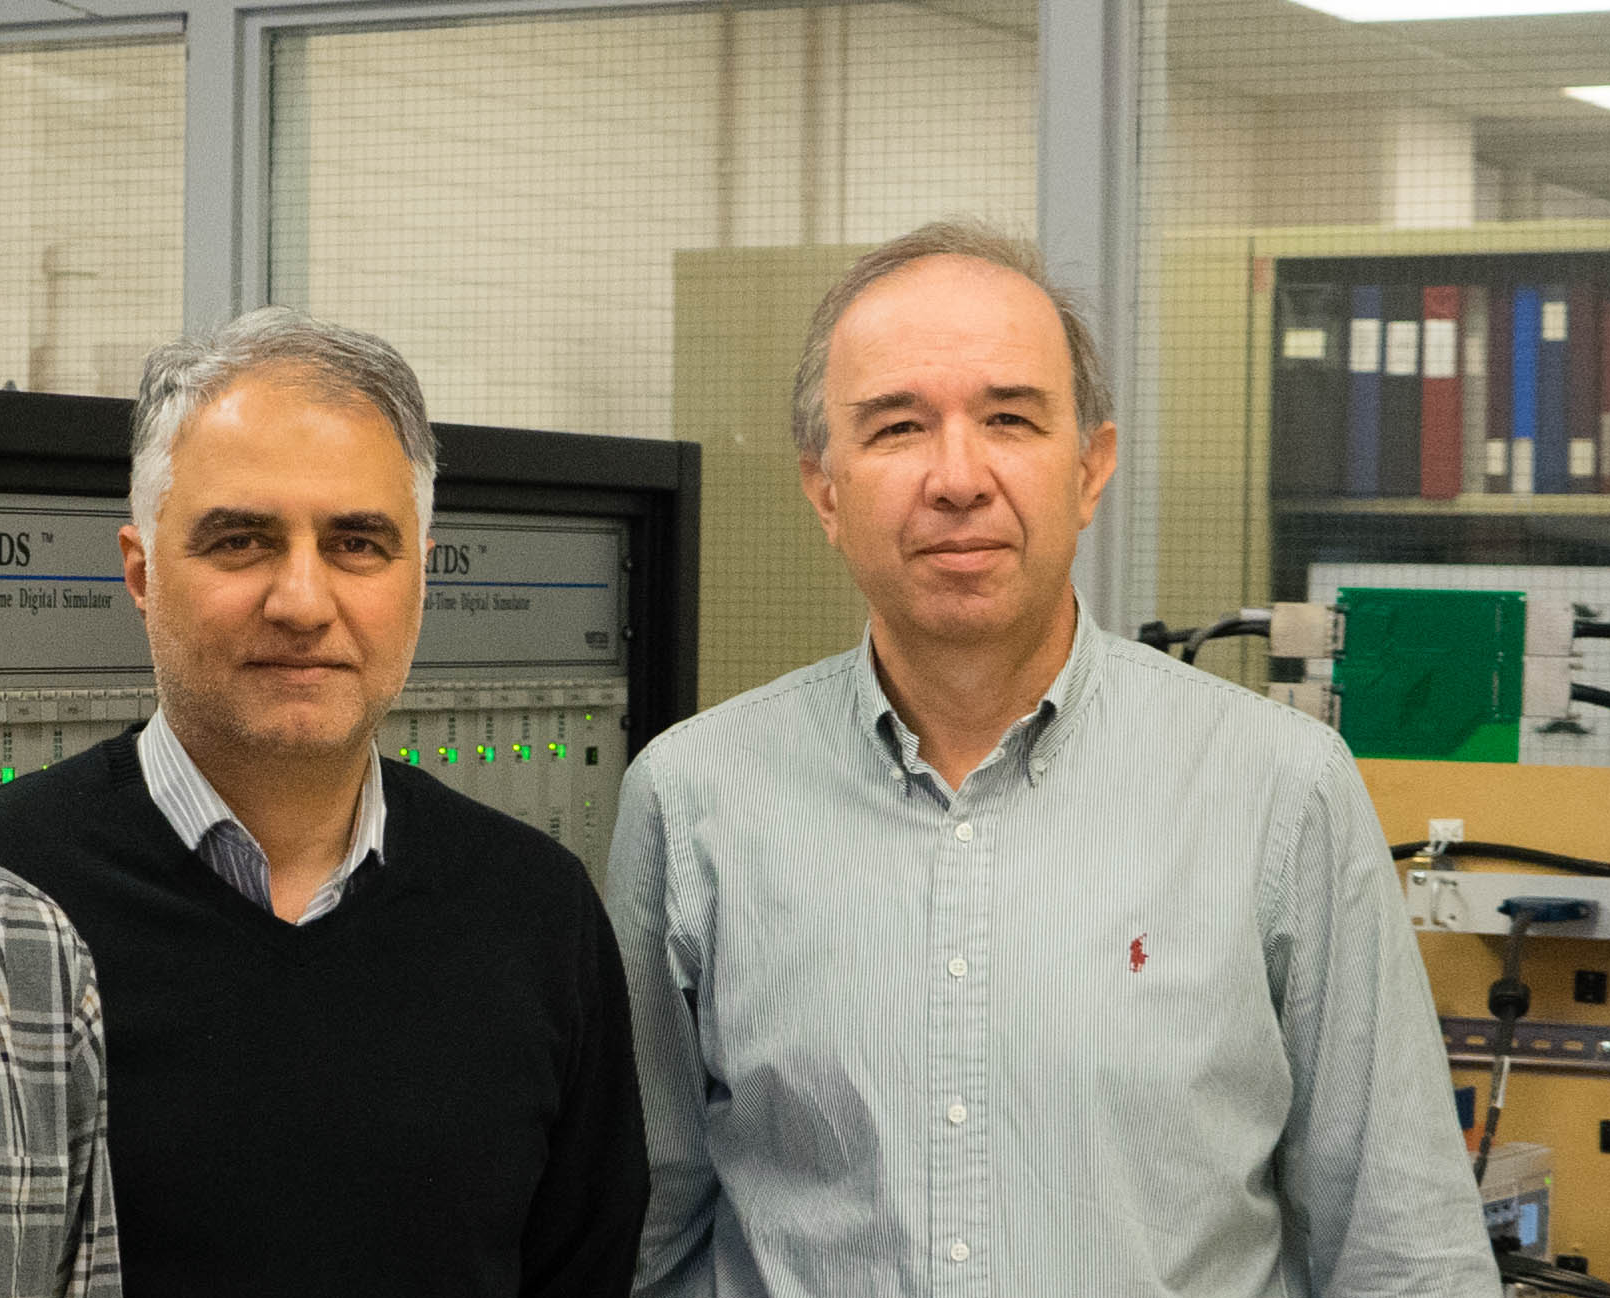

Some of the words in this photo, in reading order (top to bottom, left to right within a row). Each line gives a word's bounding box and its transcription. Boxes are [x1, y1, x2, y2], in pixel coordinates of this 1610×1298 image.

[41, 532, 54, 543] TM
[19, 587, 57, 615] Digital
[62, 588, 113, 609] Simulator
